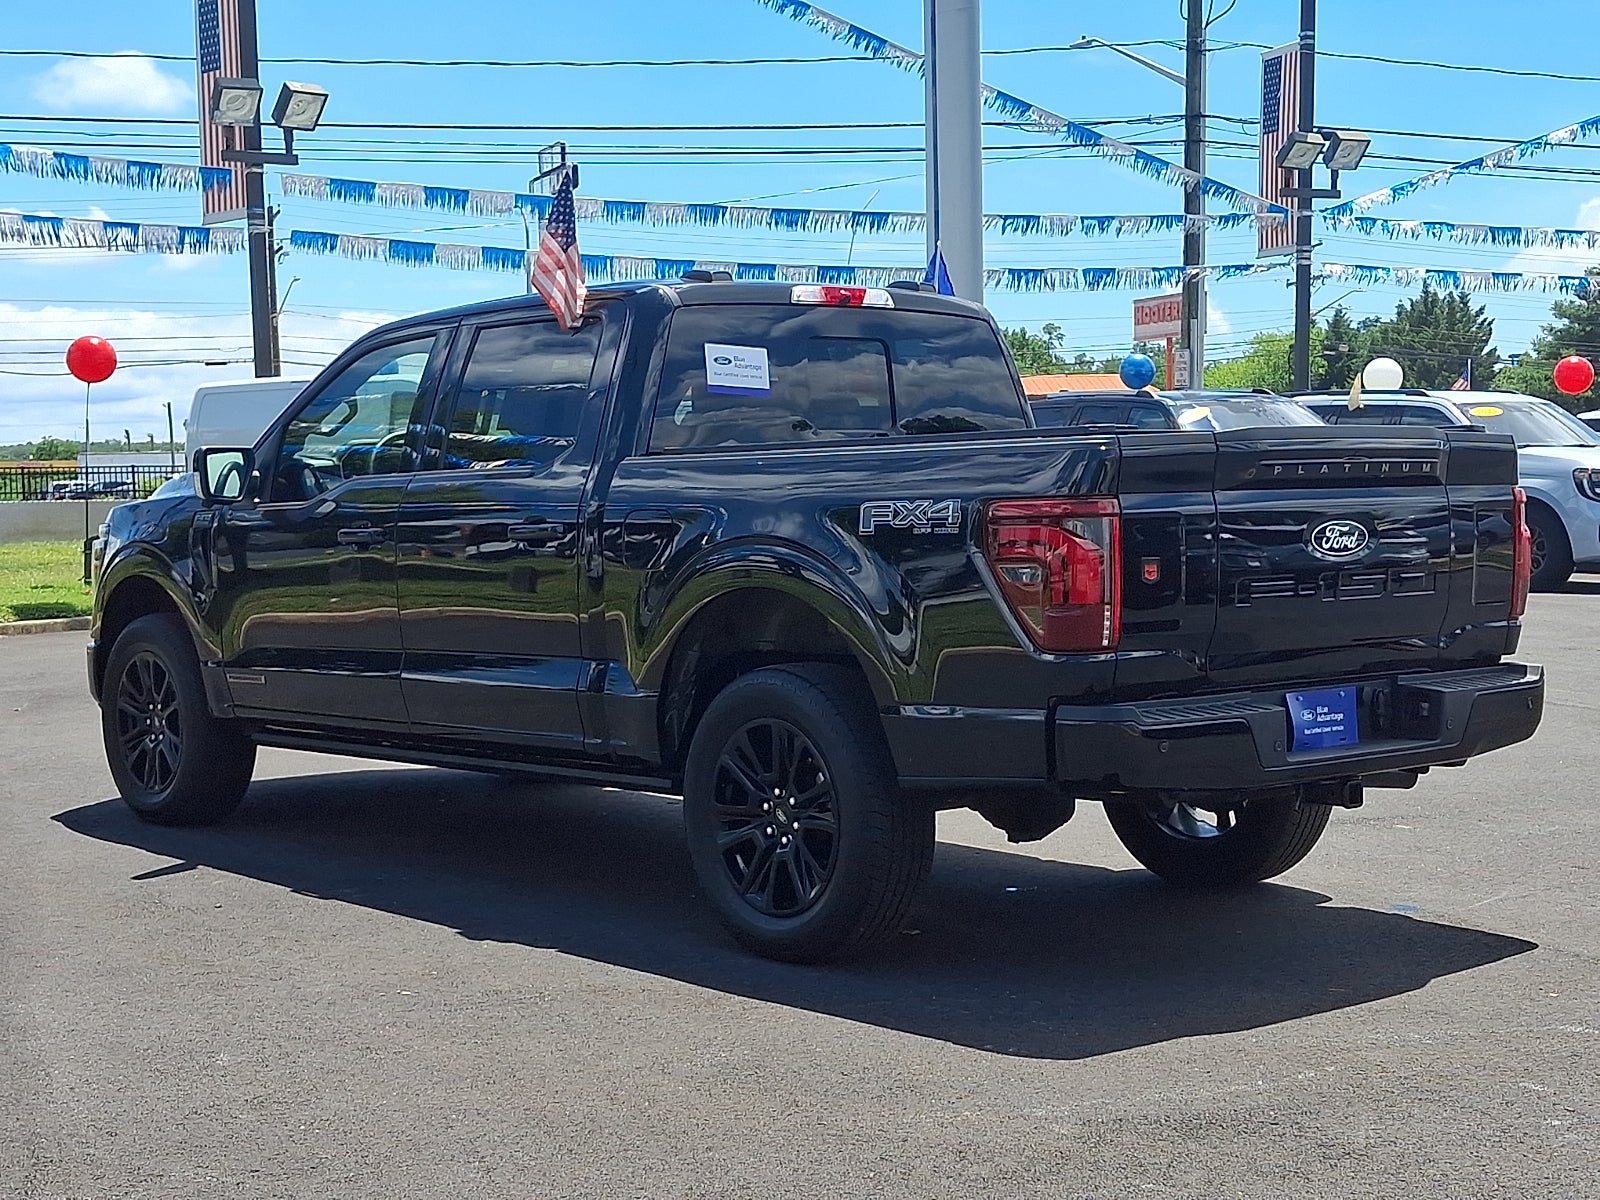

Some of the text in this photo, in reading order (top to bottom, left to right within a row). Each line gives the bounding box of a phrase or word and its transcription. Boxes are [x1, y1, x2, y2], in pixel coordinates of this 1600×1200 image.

[1134, 301, 1182, 325] HOOTER
[1273, 463, 1432, 475] PLATINUM
[859, 499, 962, 535] FX4
[1320, 524, 1360, 550] Ford
[1235, 567, 1436, 607] F-150
[1316, 712, 1344, 721] Advantage
